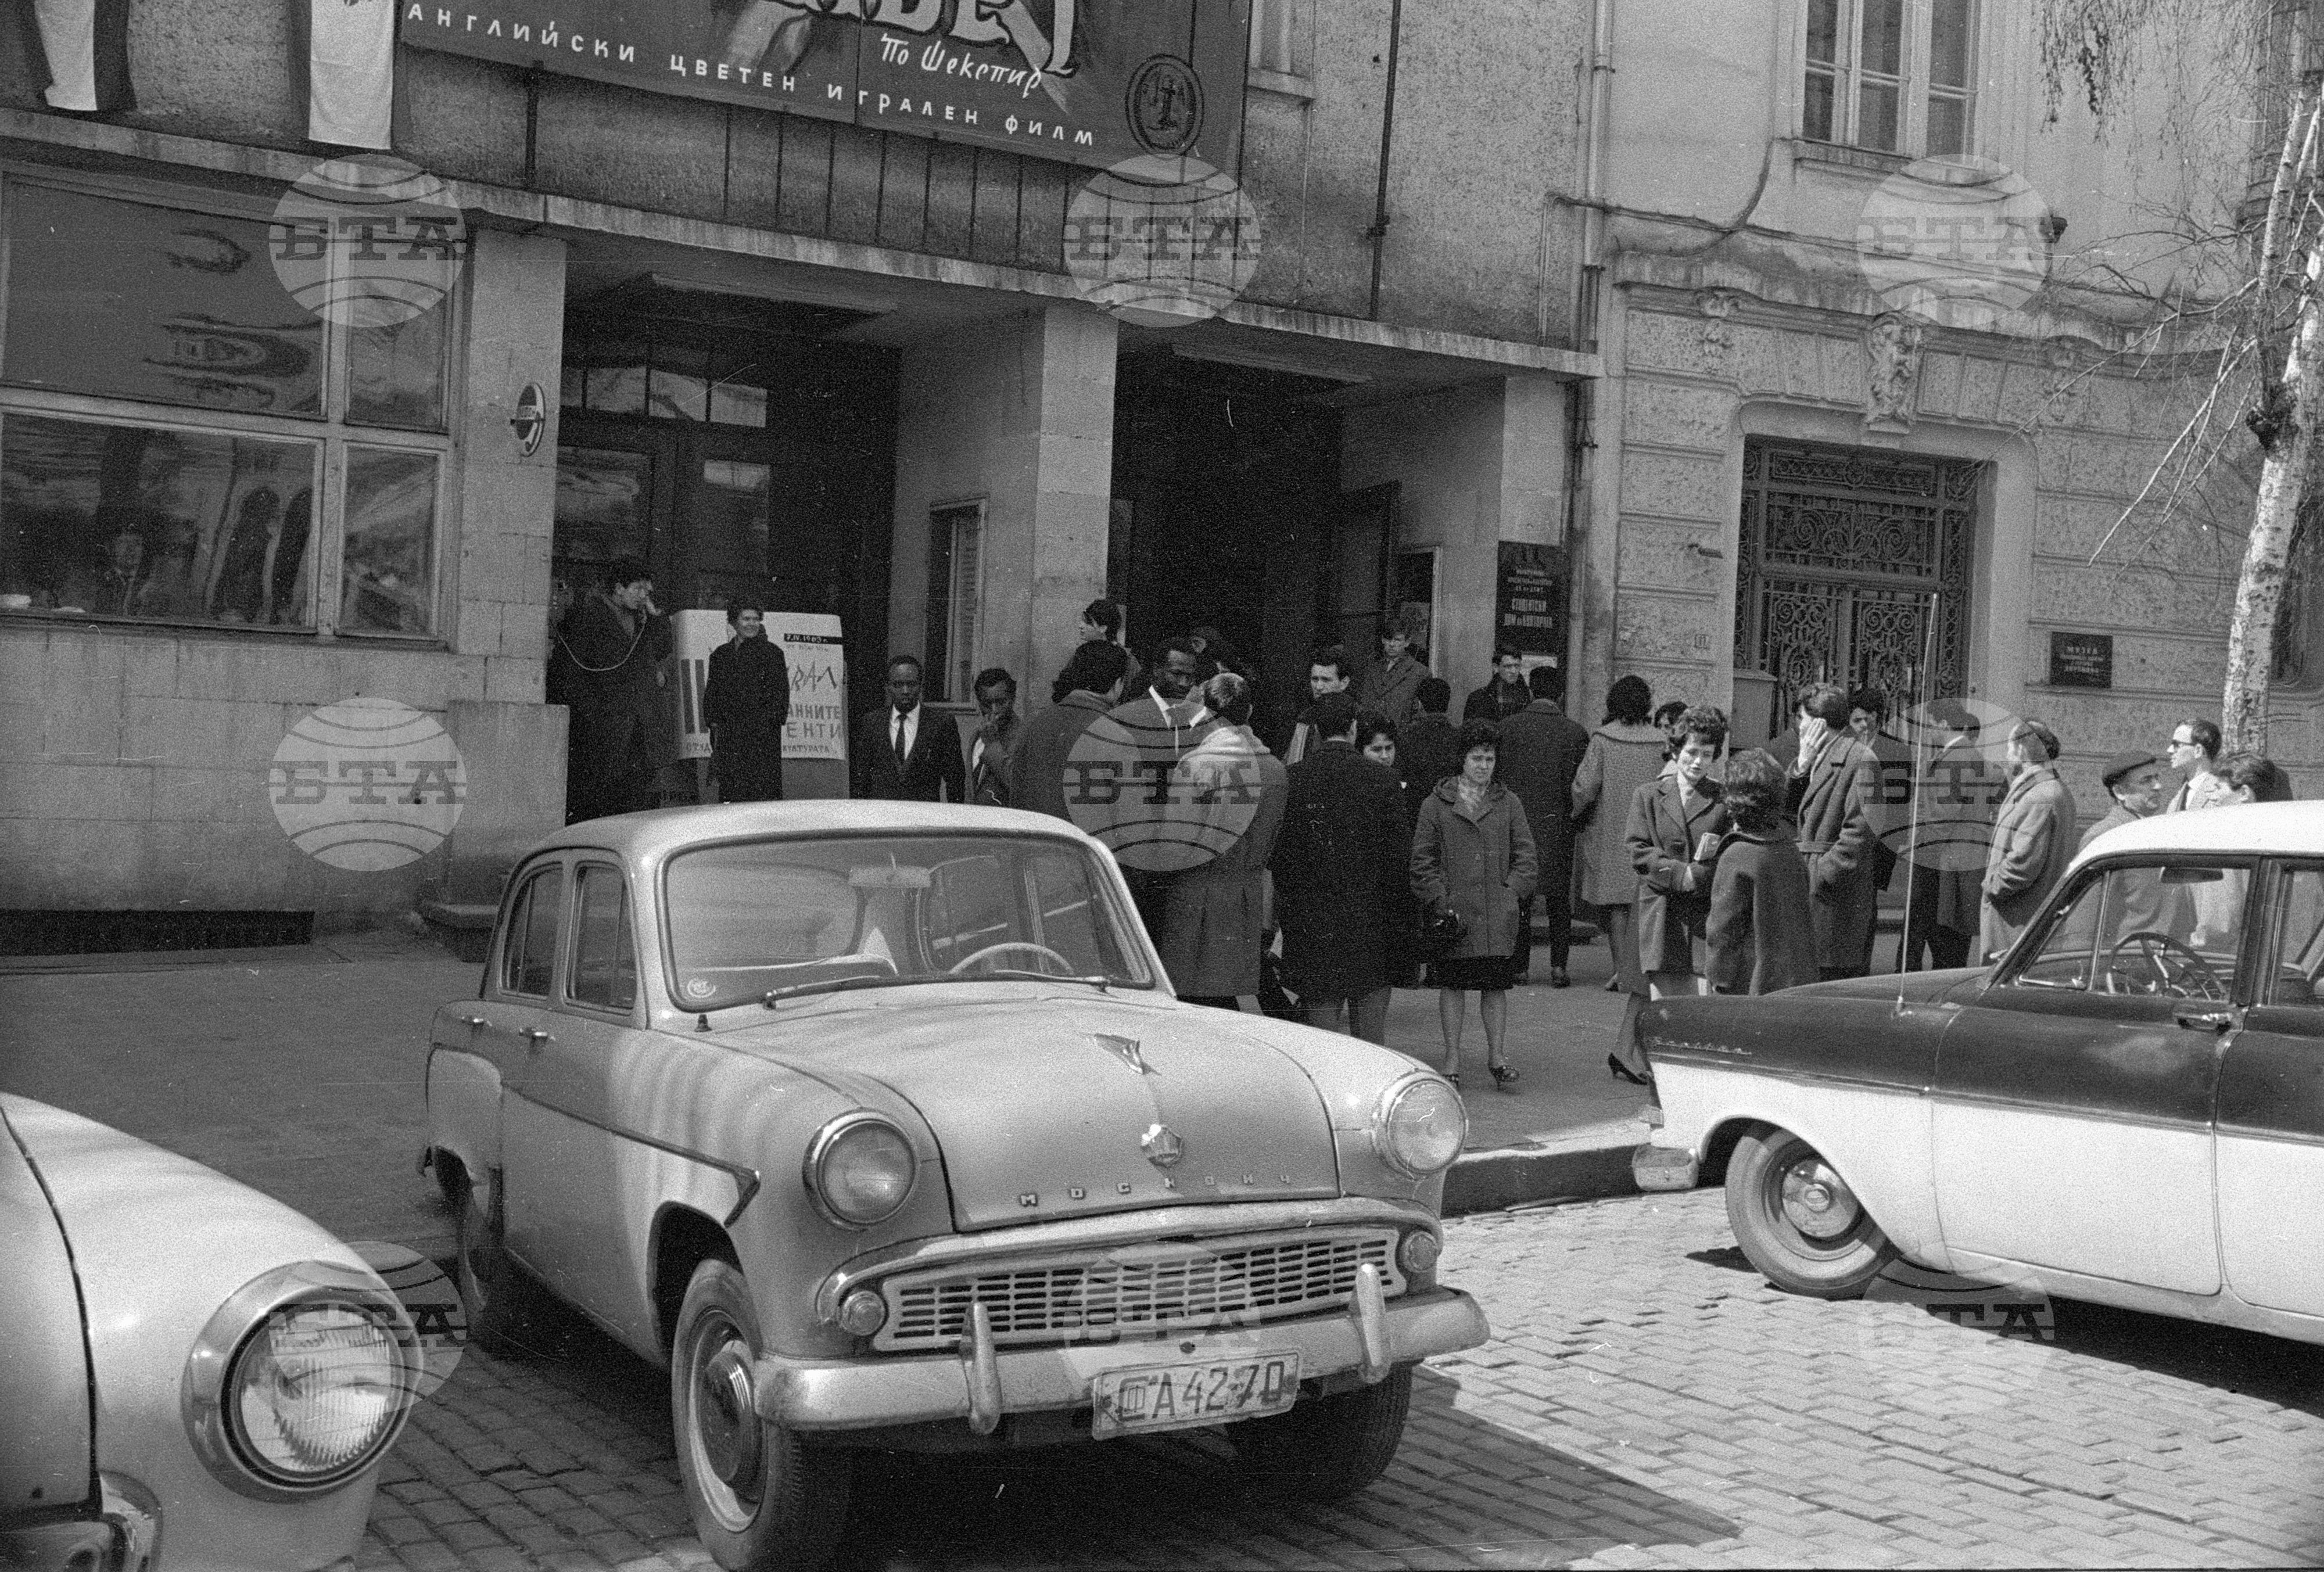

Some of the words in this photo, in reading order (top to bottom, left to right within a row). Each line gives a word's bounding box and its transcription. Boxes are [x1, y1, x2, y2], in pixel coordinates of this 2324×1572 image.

[407, 3, 636, 63] АНГЛИЙСКИ
[670, 55, 795, 92] ЦВЕТЕН
[827, 83, 978, 125] ИГРАЛЕН
[1005, 114, 1093, 146] ФИЛМ
[880, 33, 910, 66] По
[920, 40, 1042, 99] Шекспир
[788, 704, 840, 720] АННИТЕ
[786, 722, 841, 738] ЕНТИ
[1020, 1173, 1290, 1207] МОСКВИЧ
